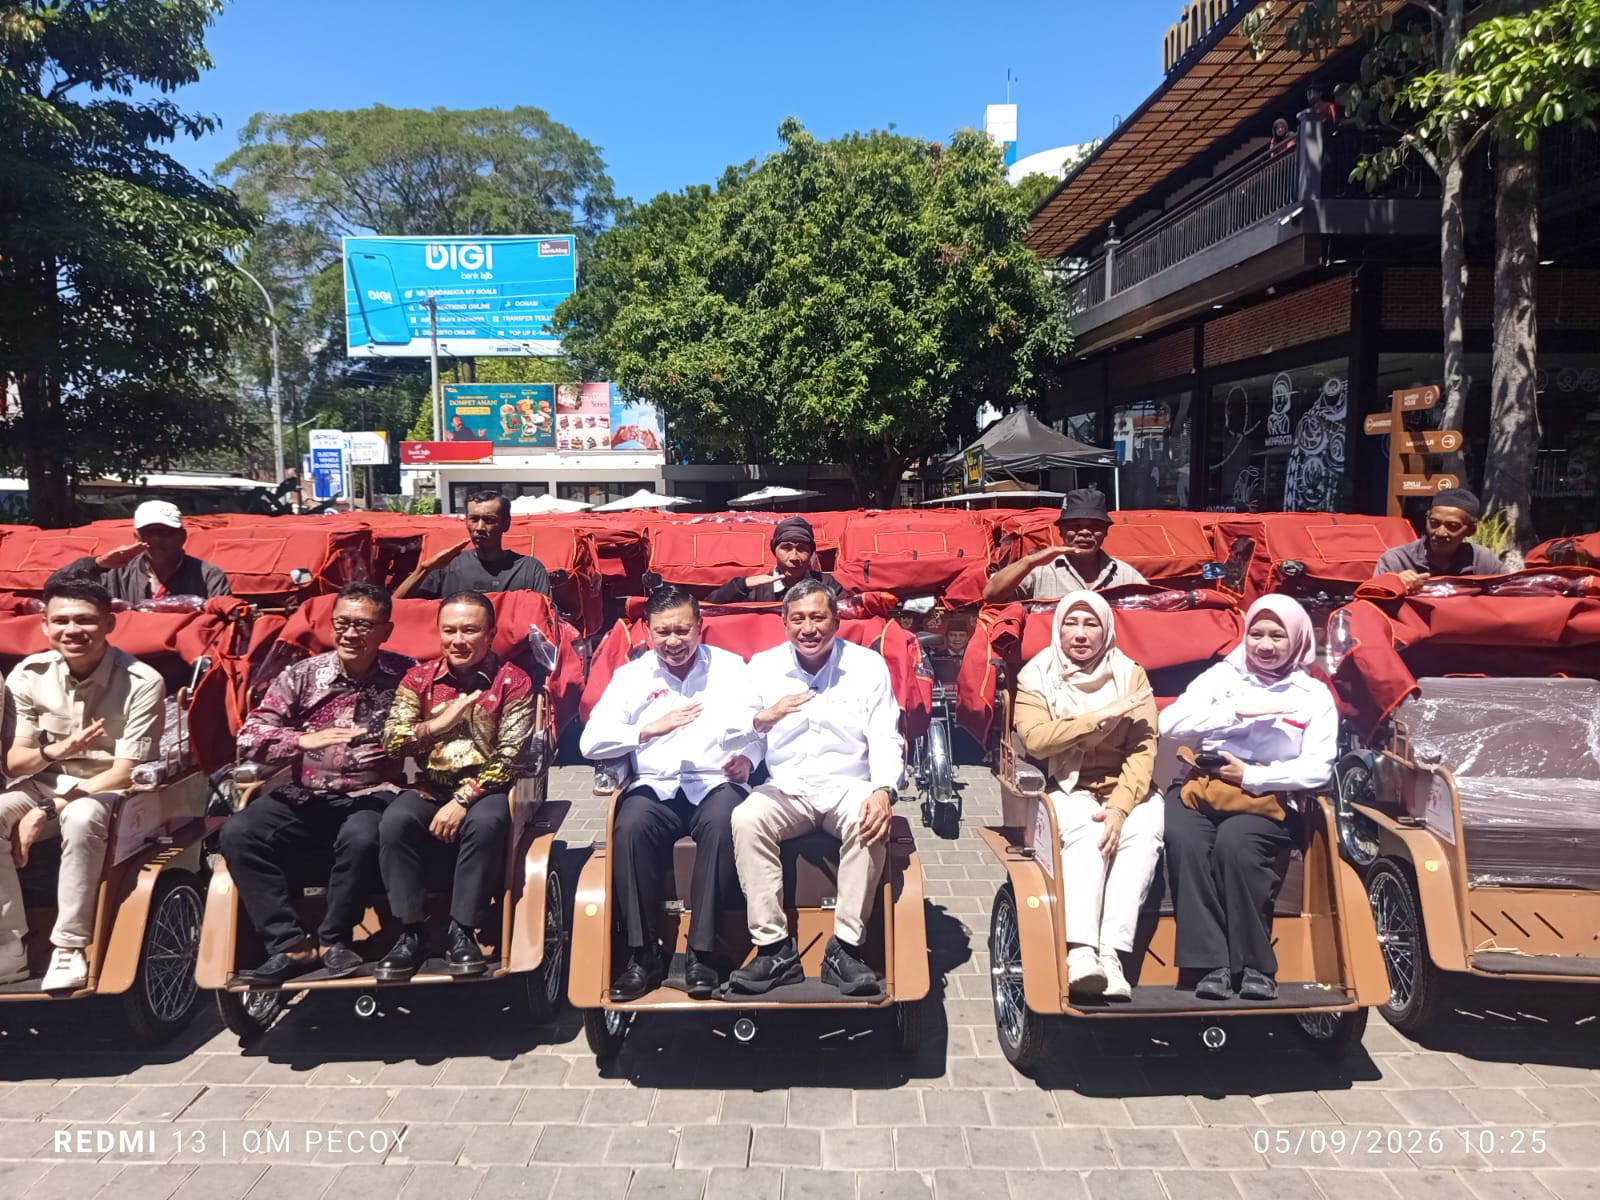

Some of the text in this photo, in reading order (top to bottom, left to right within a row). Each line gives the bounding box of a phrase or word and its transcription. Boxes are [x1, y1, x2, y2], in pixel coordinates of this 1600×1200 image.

[425, 243, 493, 270] DIGI
[480, 272, 493, 280] bjb
[368, 290, 392, 301] DIGI
